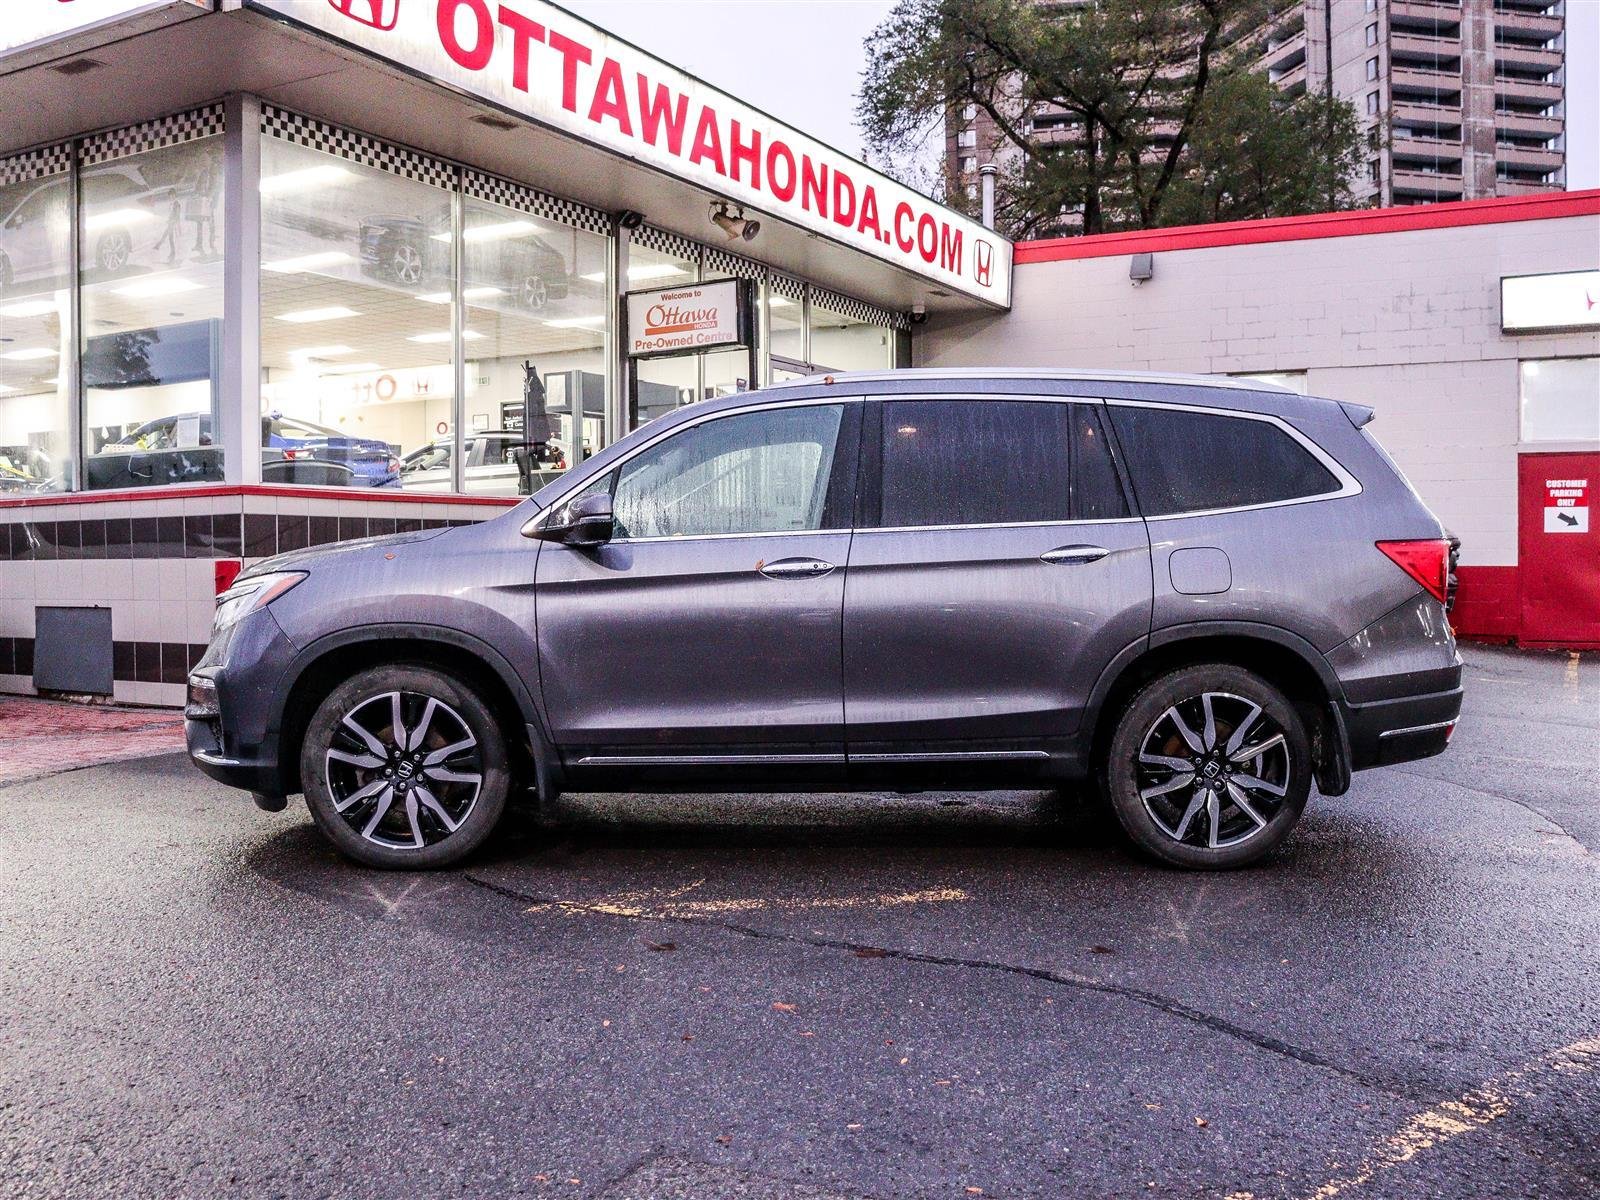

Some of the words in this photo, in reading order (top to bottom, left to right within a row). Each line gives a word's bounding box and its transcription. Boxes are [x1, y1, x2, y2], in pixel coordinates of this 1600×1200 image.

[437, 0, 963, 276] OTTAWAHONDA.COM
[661, 290, 693, 301] Welcome
[694, 290, 702, 298] to
[646, 304, 718, 327] Ottawa
[694, 321, 717, 329] HONDA
[635, 334, 693, 350] Pre-Owned
[696, 331, 733, 344] Centre
[1545, 479, 1587, 488] CUSTOMER
[1549, 489, 1583, 497] PARKING
[1557, 498, 1576, 506] ONLY
